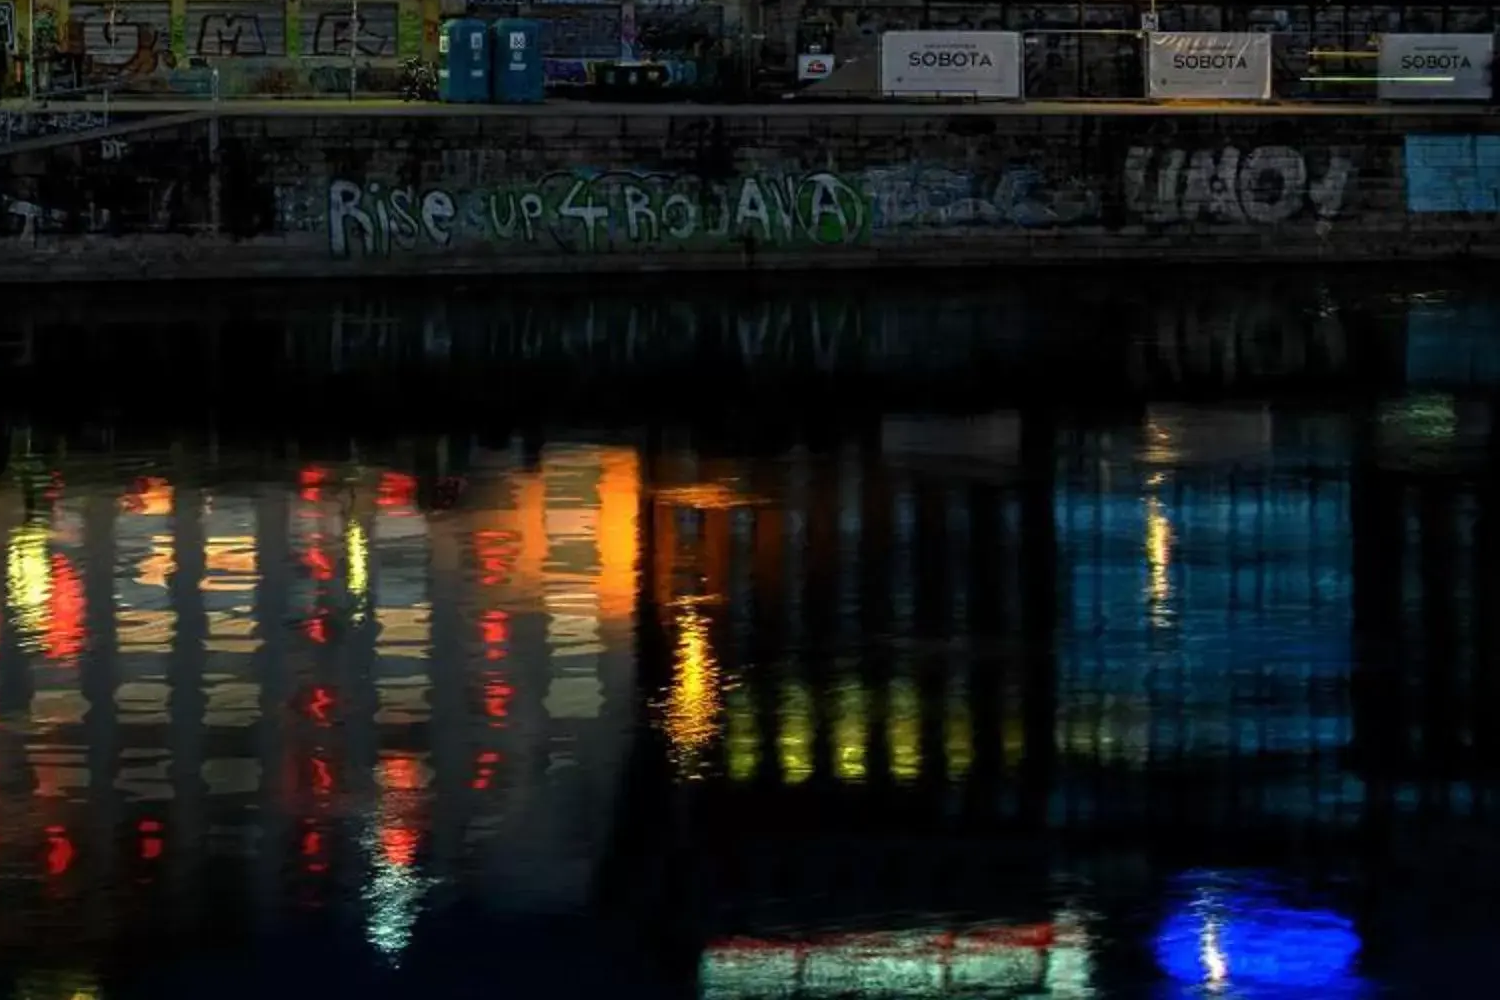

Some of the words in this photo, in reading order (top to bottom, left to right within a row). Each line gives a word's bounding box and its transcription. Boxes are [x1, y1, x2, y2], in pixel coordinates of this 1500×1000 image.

[908, 51, 993, 67] SOBOTA
[1173, 54, 1247, 70] SOBOTA
[1400, 55, 1472, 69] SOBOTA
[557, 179, 610, 253] 4
